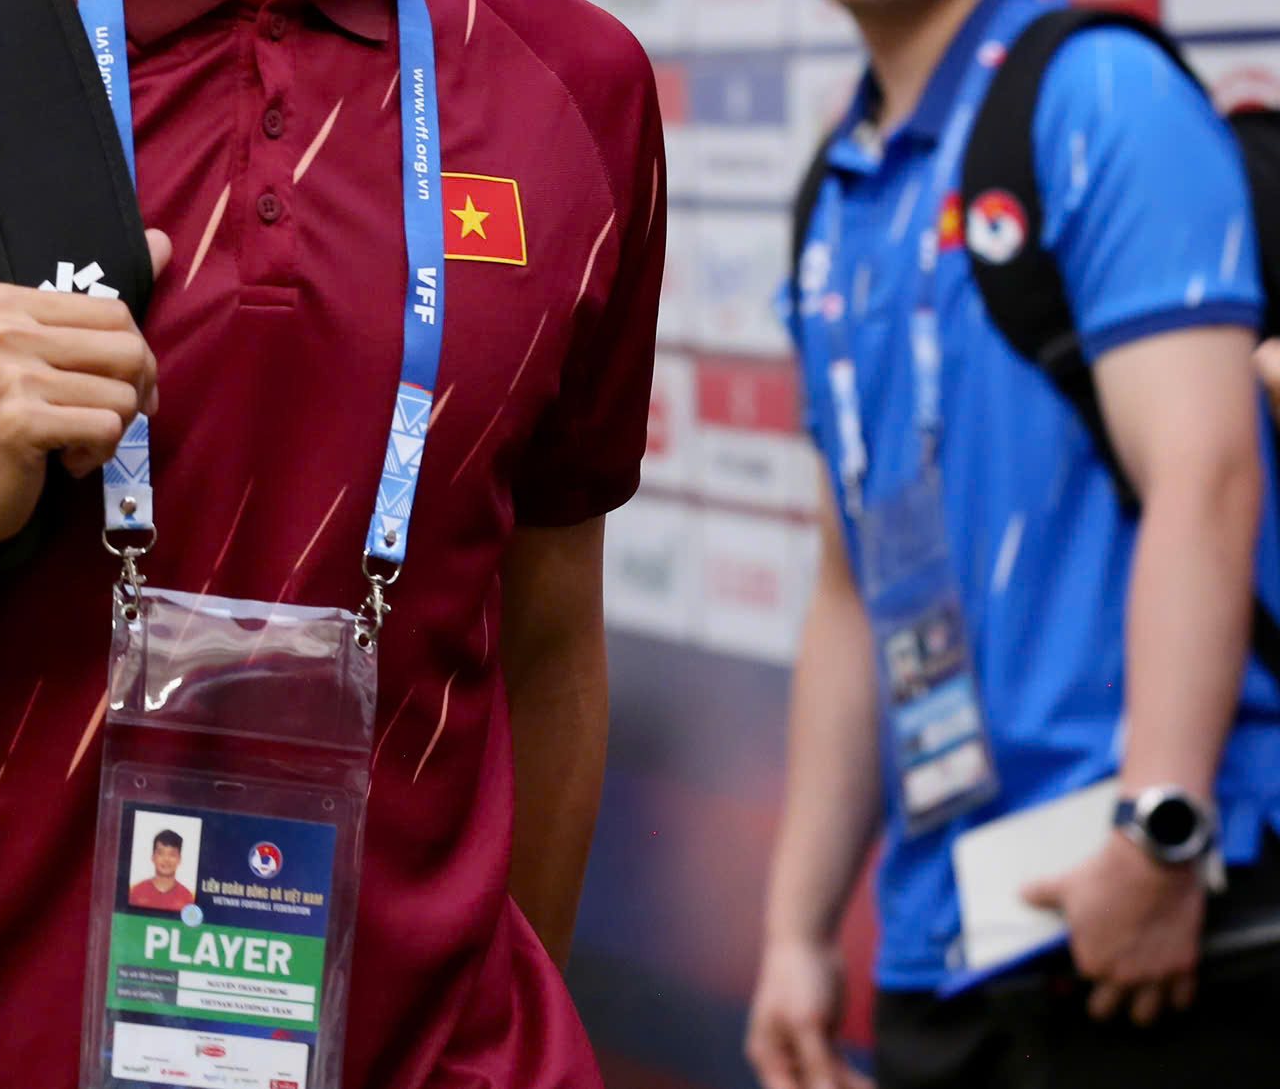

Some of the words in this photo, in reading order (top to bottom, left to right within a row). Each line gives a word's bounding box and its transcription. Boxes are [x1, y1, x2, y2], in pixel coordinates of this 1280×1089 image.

[413, 68, 430, 200] www.vff.org.vn
[414, 267, 437, 325] VFF
[144, 925, 293, 976] PLAYER
